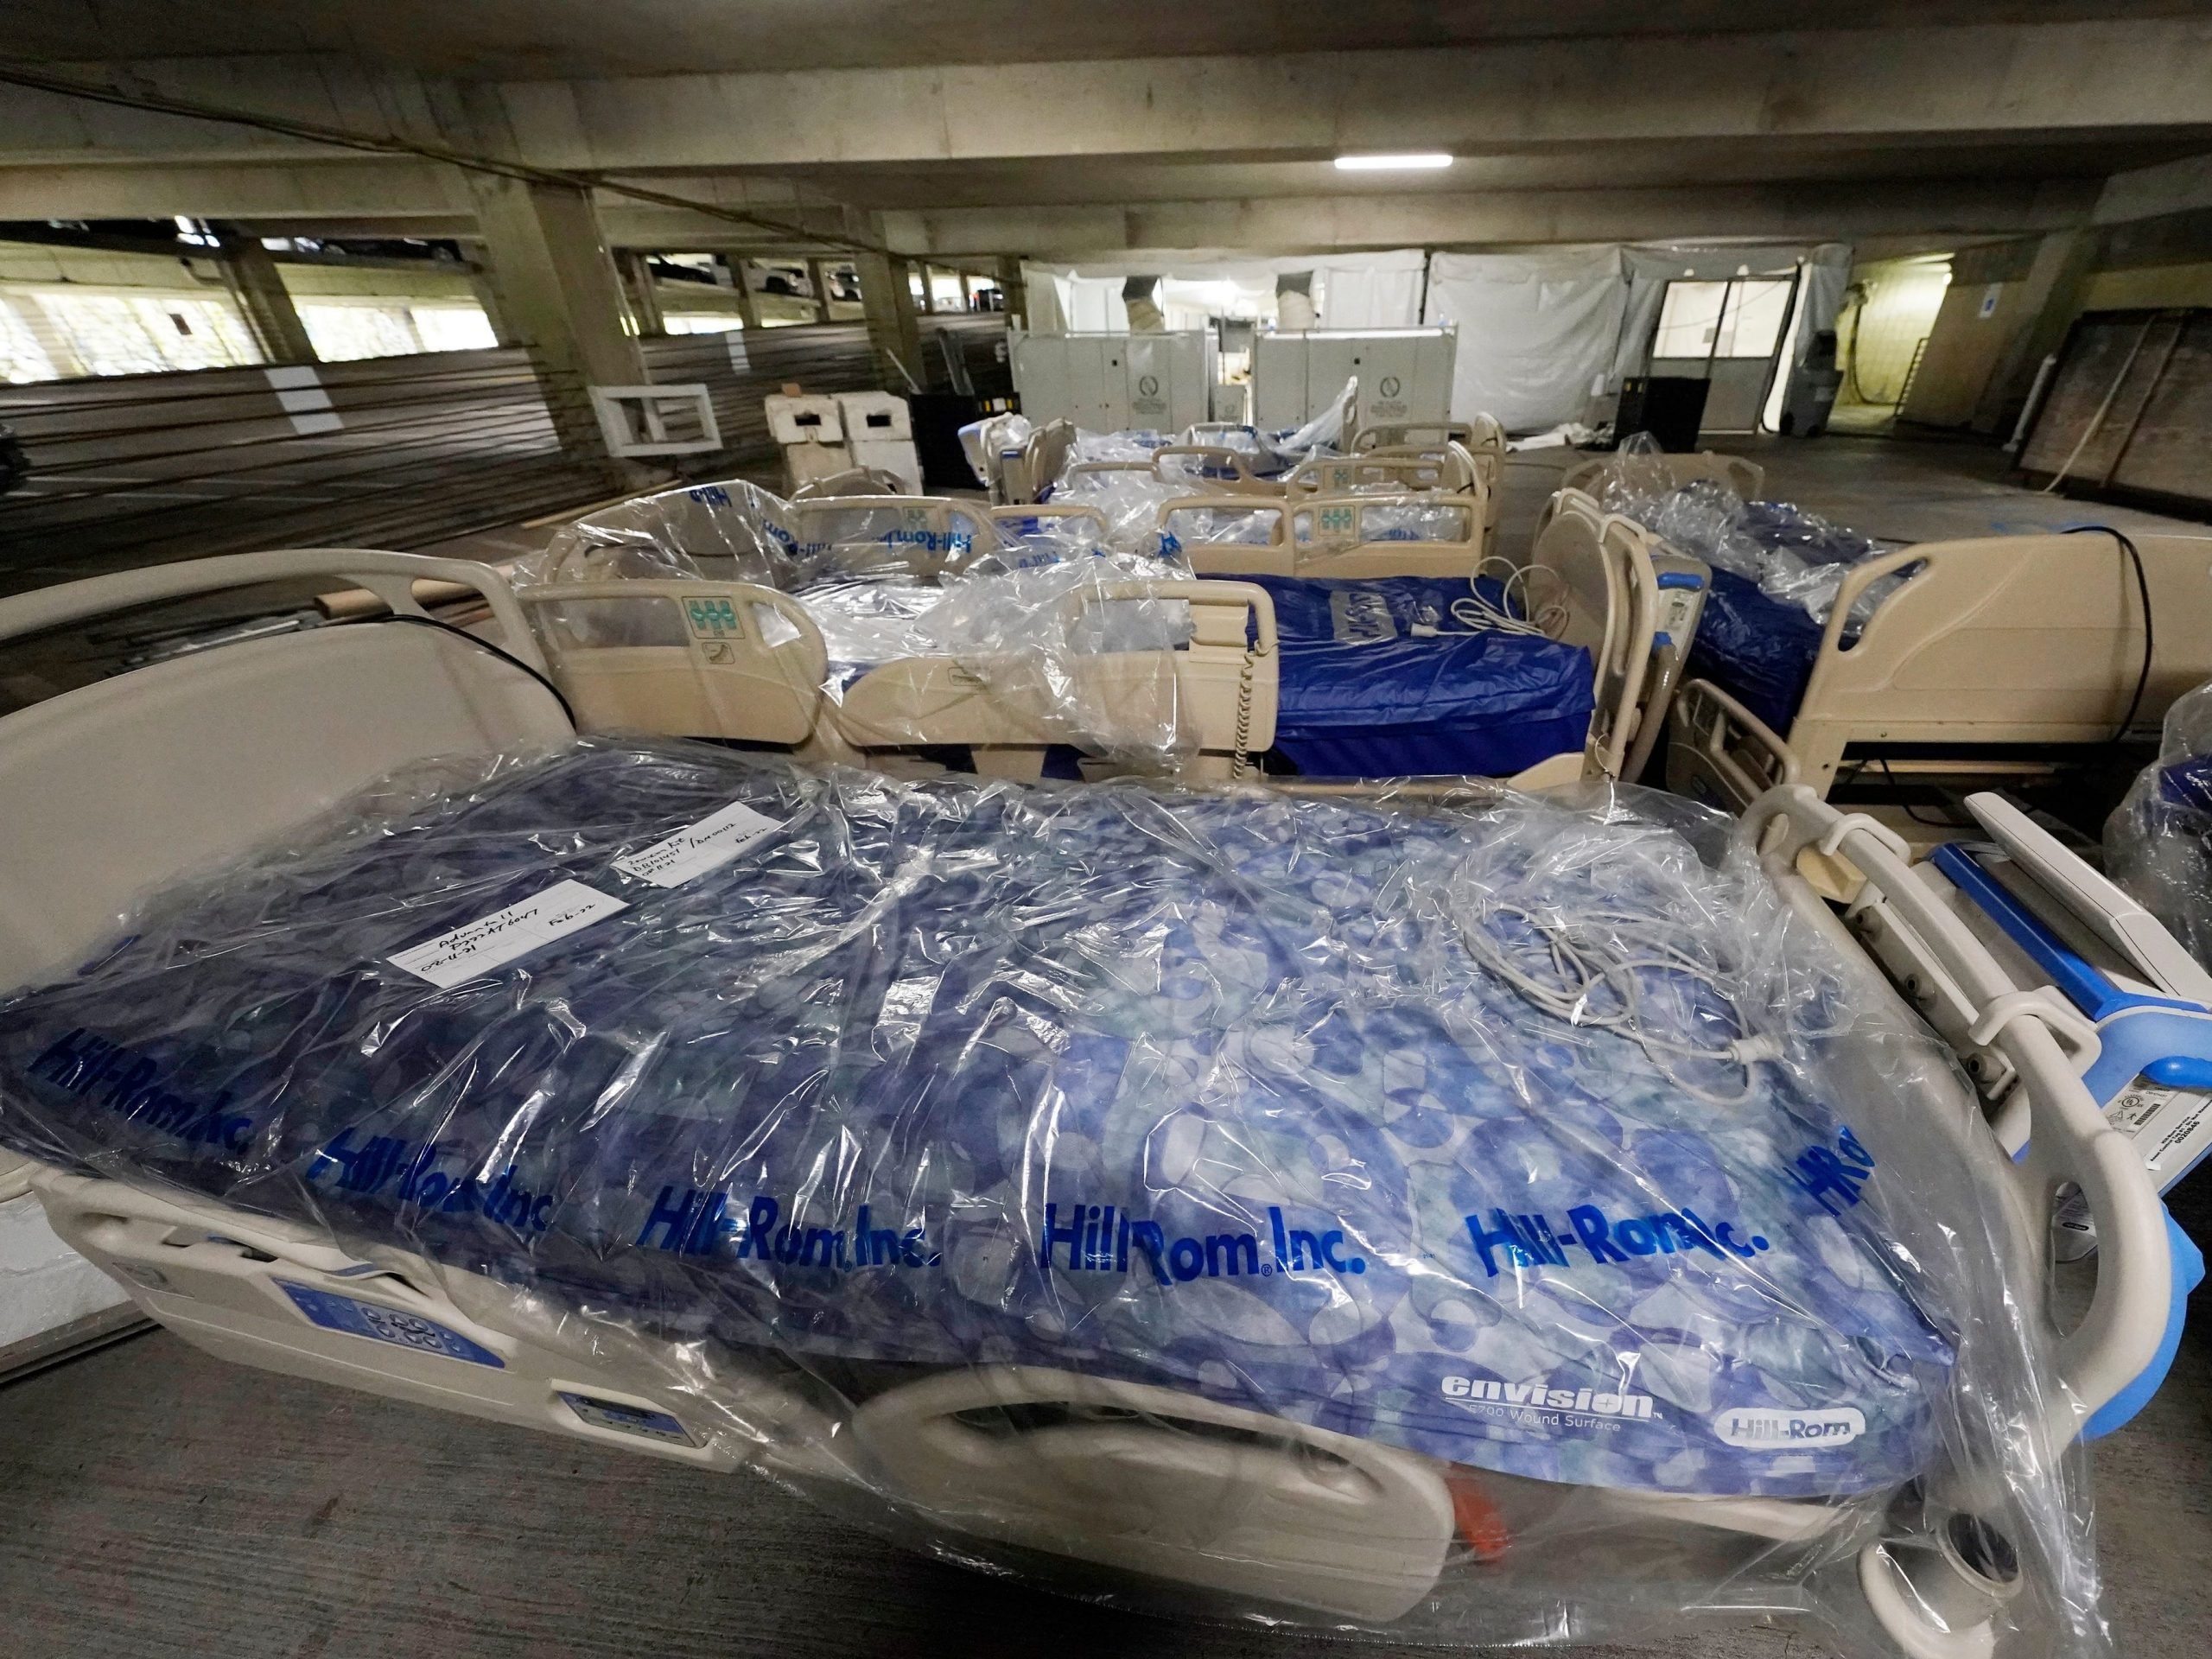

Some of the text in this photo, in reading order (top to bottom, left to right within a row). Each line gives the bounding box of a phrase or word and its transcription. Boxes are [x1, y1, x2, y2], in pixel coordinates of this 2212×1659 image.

[1268, 1206, 1366, 1275] Inc.
[1510, 1409, 1560, 1426] Wound
[1565, 1416, 1621, 1432] Surface
[1731, 1417, 1851, 1440] Hill-Rom
